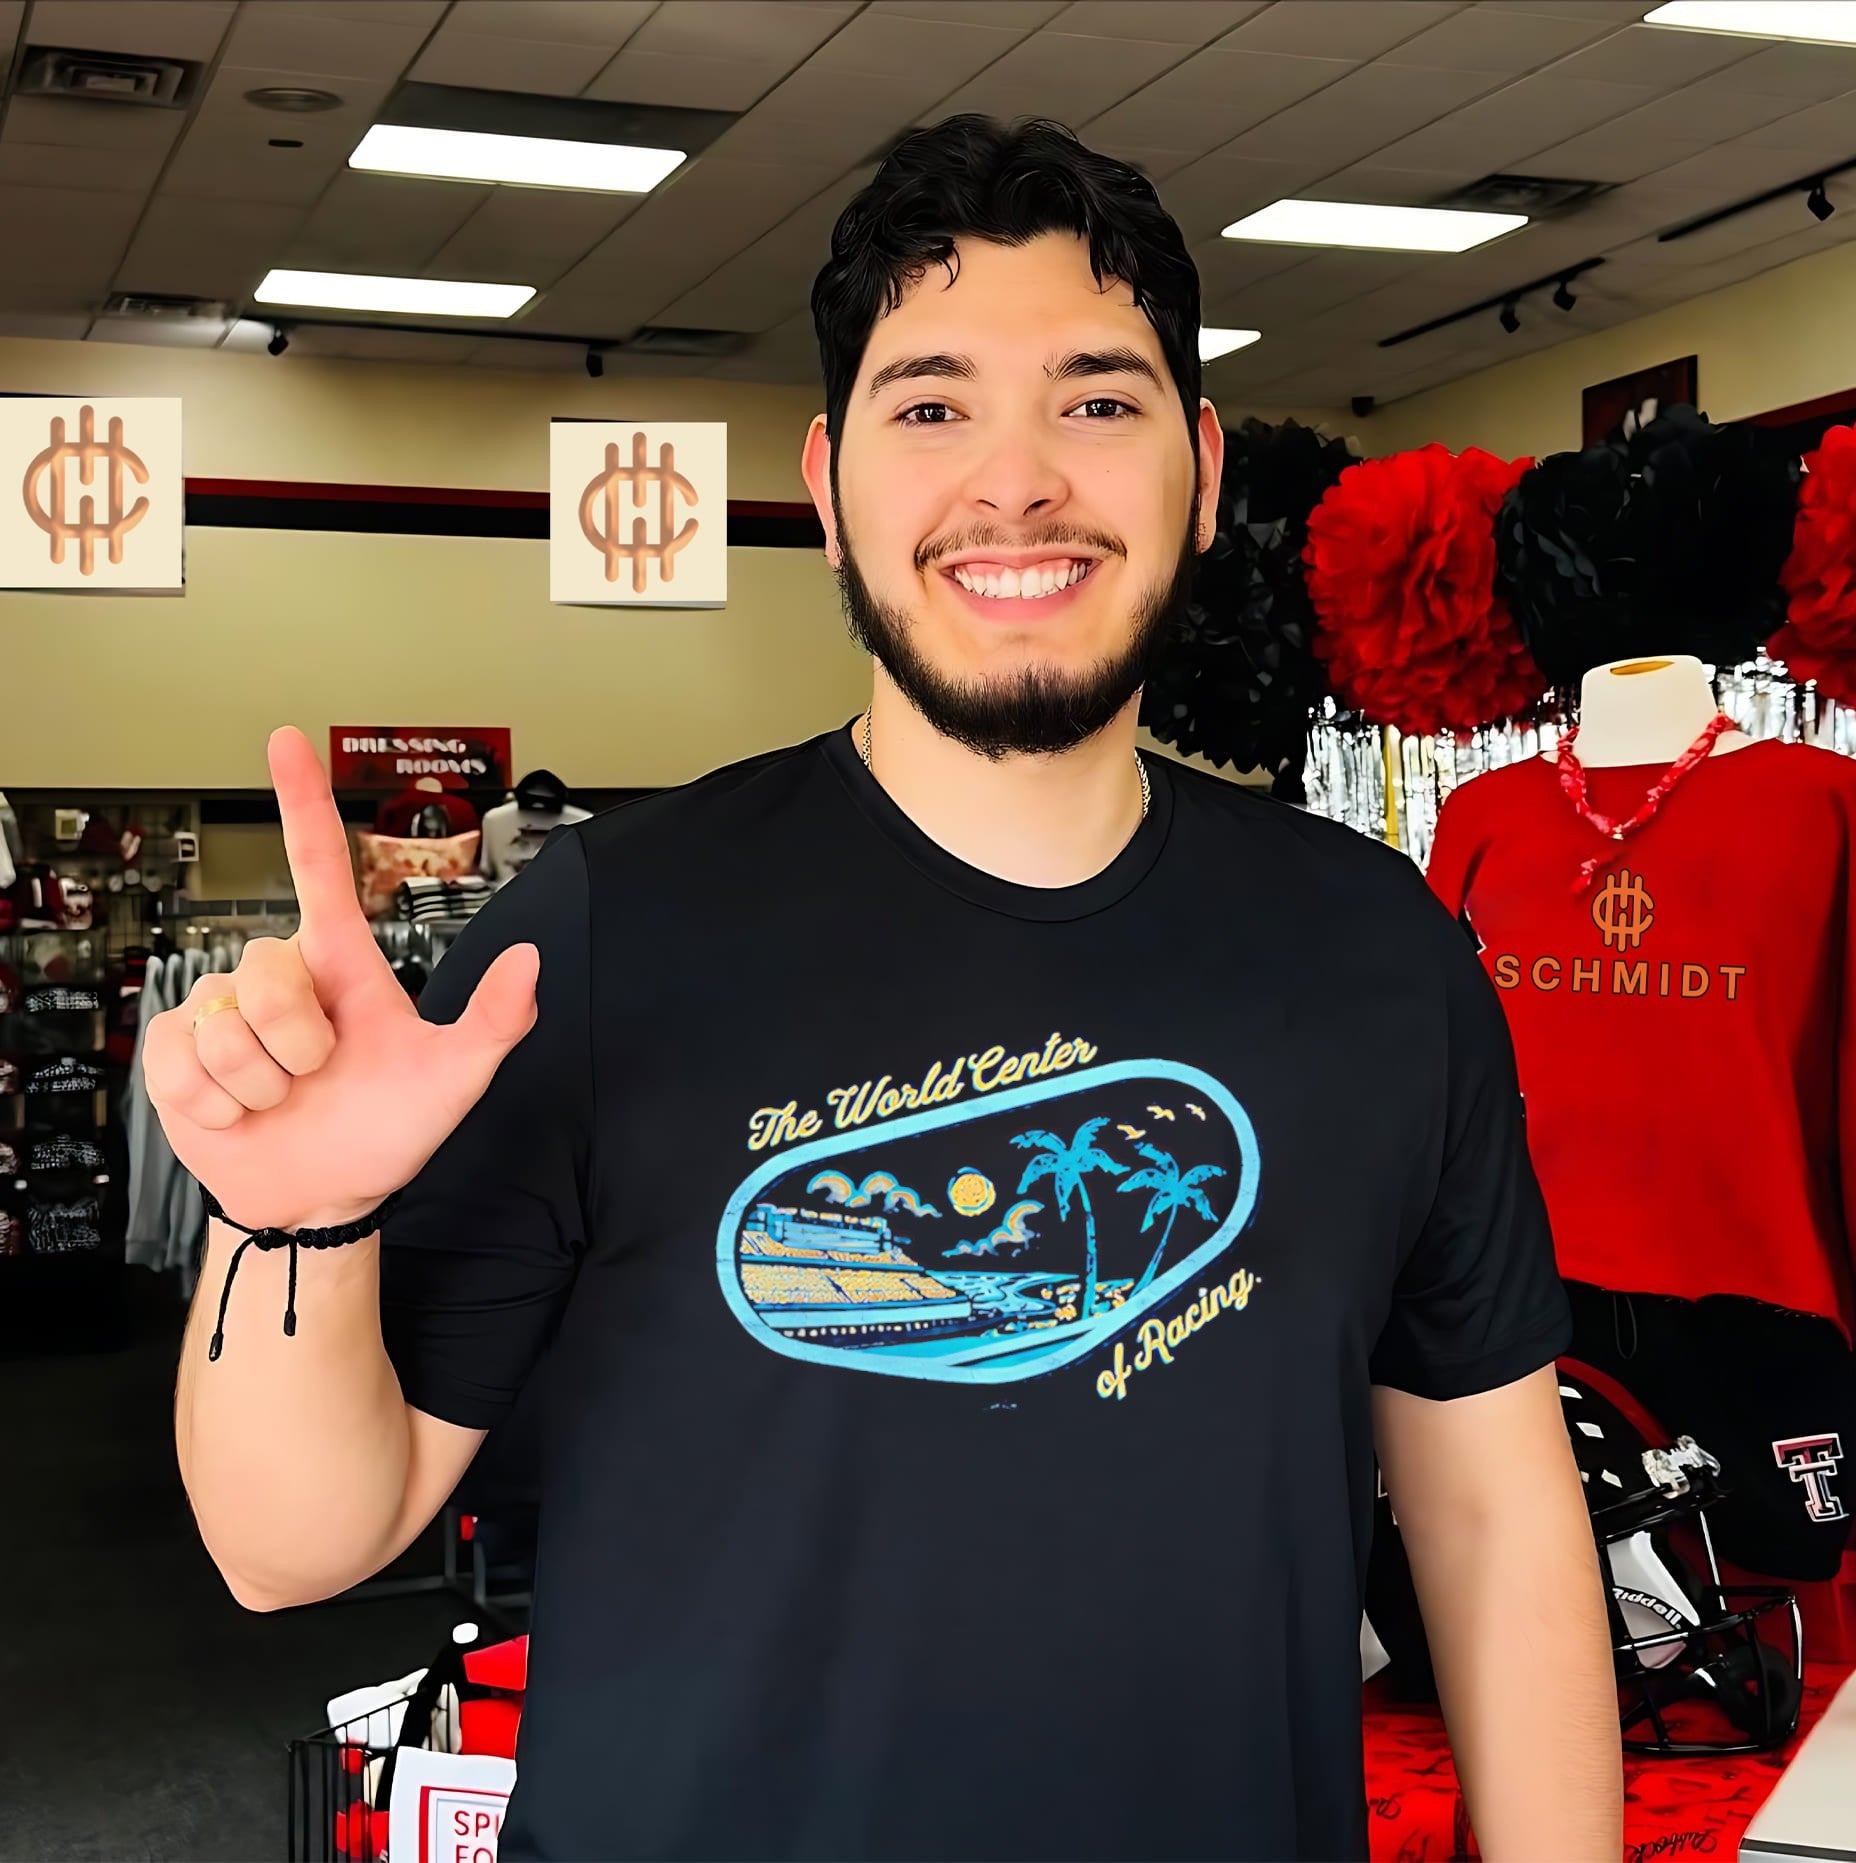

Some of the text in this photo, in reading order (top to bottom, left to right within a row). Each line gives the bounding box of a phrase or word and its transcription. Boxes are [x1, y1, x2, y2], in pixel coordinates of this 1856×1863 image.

[342, 737, 467, 754] DRESSING
[396, 758, 487, 775] ROOMS
[1493, 953, 1747, 1001] SCHMIDT
[748, 1032, 1098, 1151] The World Center
[1096, 1342, 1132, 1400] of
